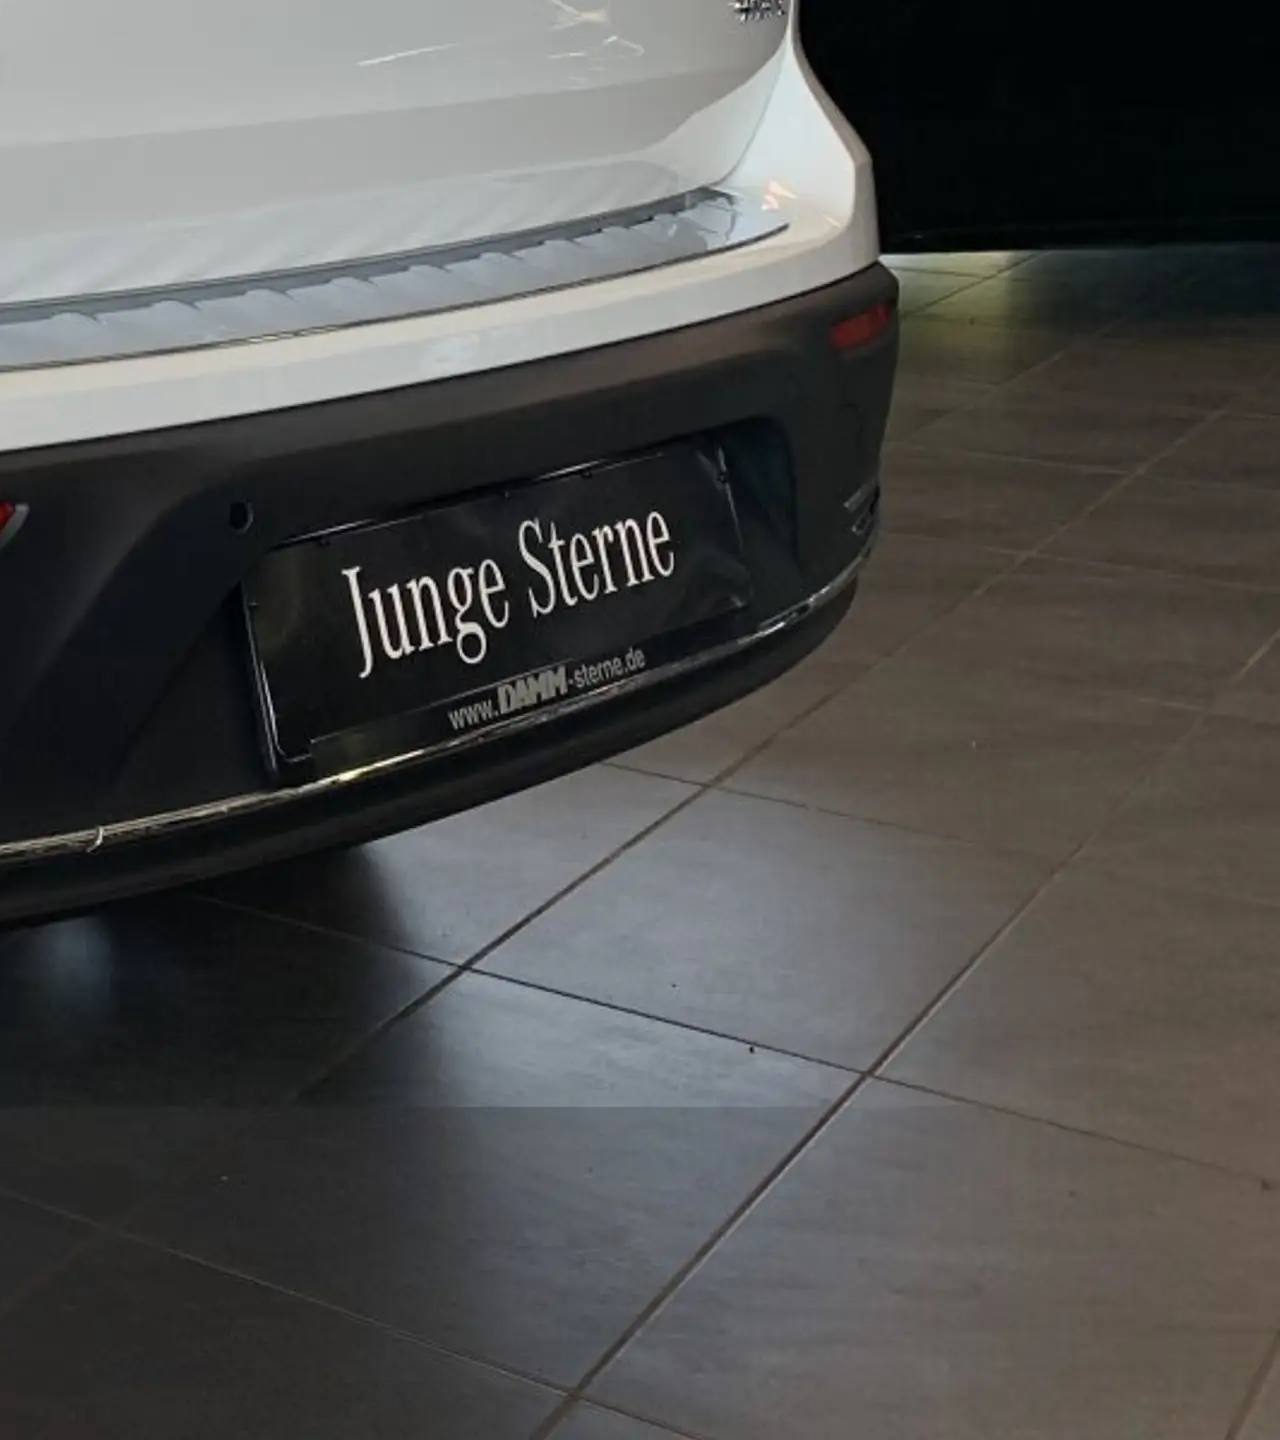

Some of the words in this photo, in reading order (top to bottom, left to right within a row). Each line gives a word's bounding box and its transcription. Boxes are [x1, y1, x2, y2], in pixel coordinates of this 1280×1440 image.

[341, 559, 509, 679] Junge
[517, 510, 675, 619] Sterne
[447, 646, 646, 731] www.DAMM-sterne.de
